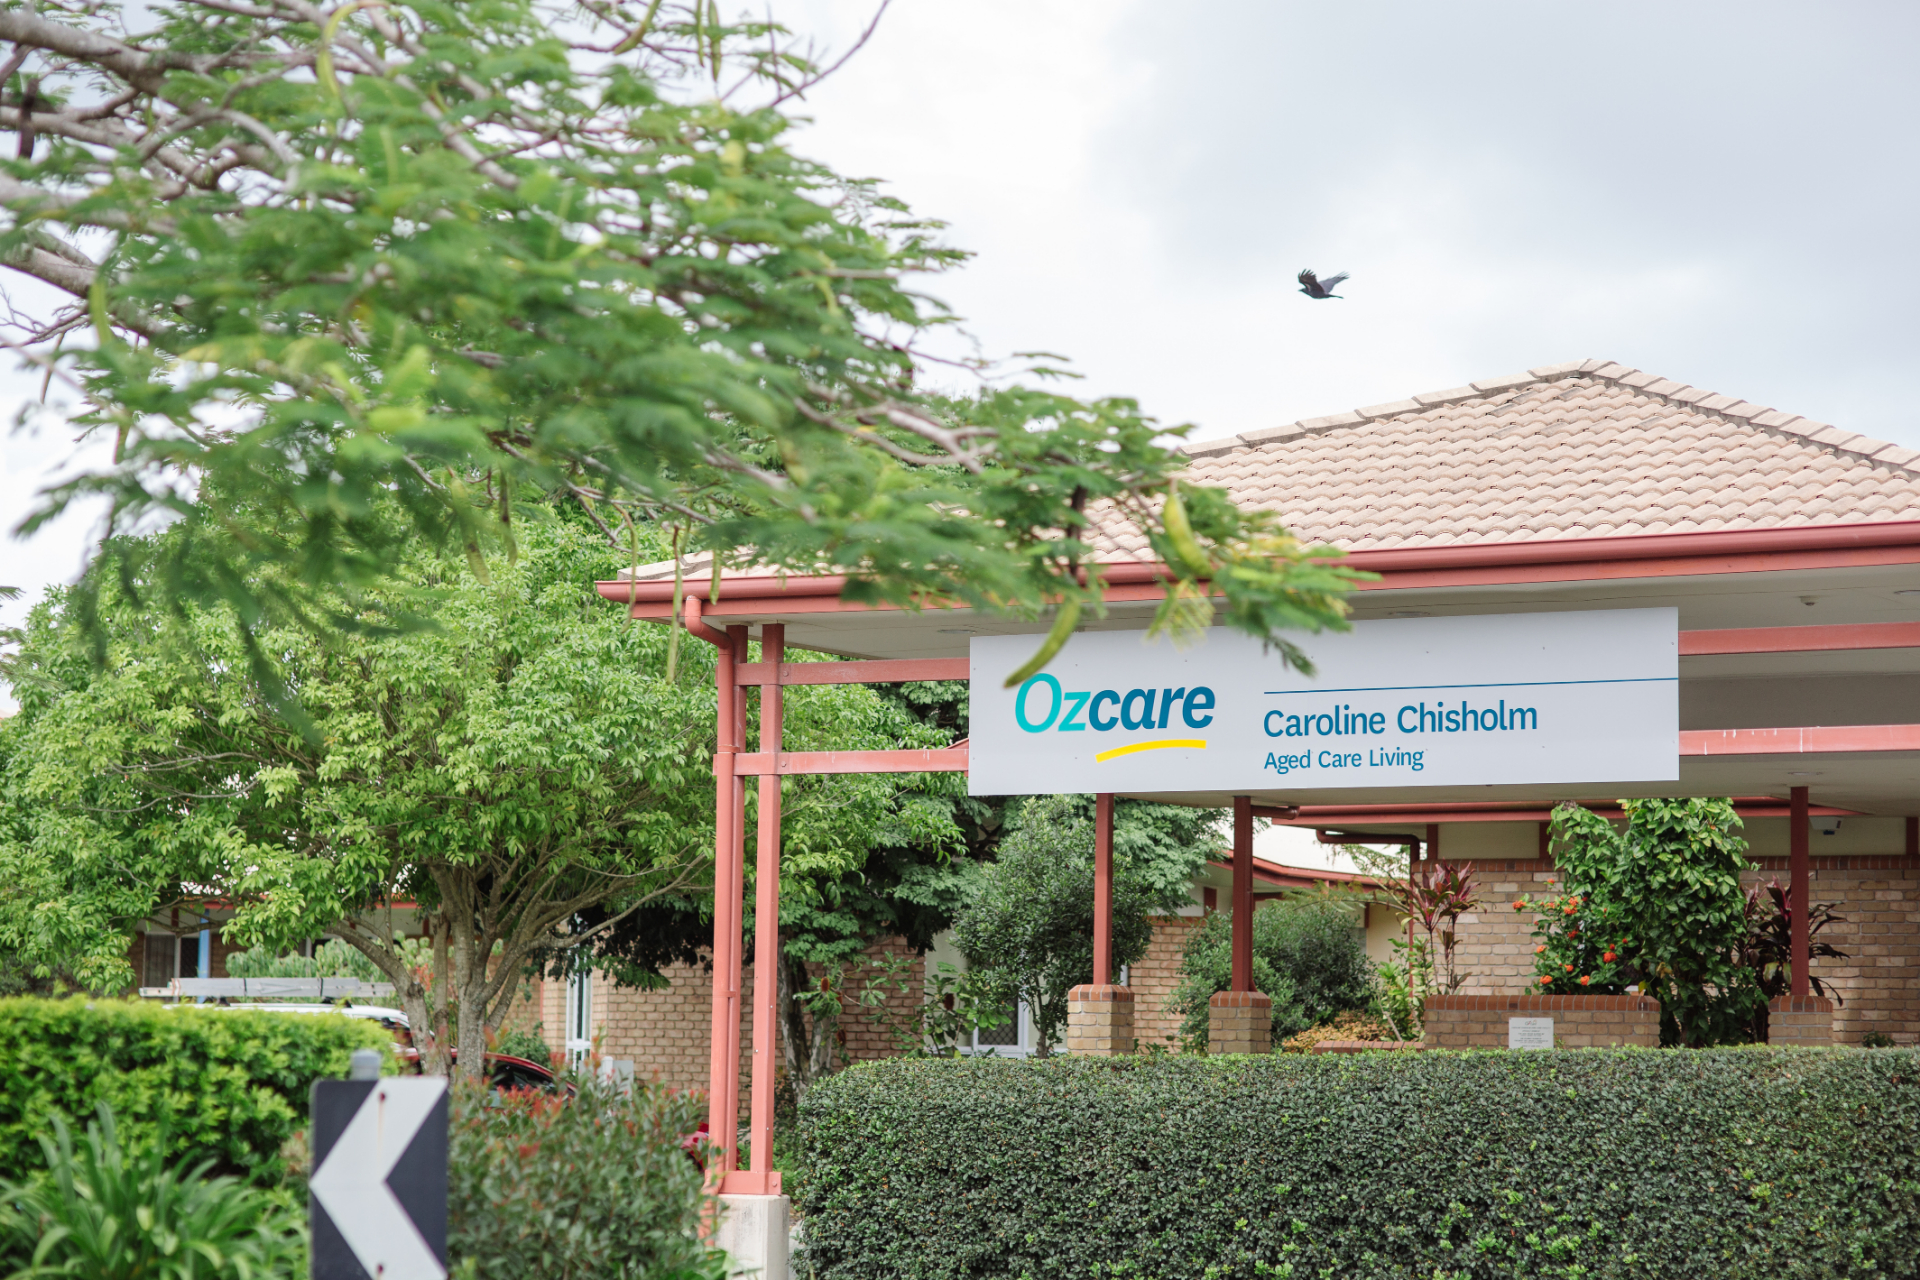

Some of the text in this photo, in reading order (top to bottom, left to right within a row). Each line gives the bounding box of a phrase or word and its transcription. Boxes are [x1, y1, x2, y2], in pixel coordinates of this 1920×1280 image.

[1015, 673, 1216, 733] Ozcare
[1263, 700, 1538, 738] Caroline Chisholm
[1264, 746, 1425, 775] Aged Care Living
